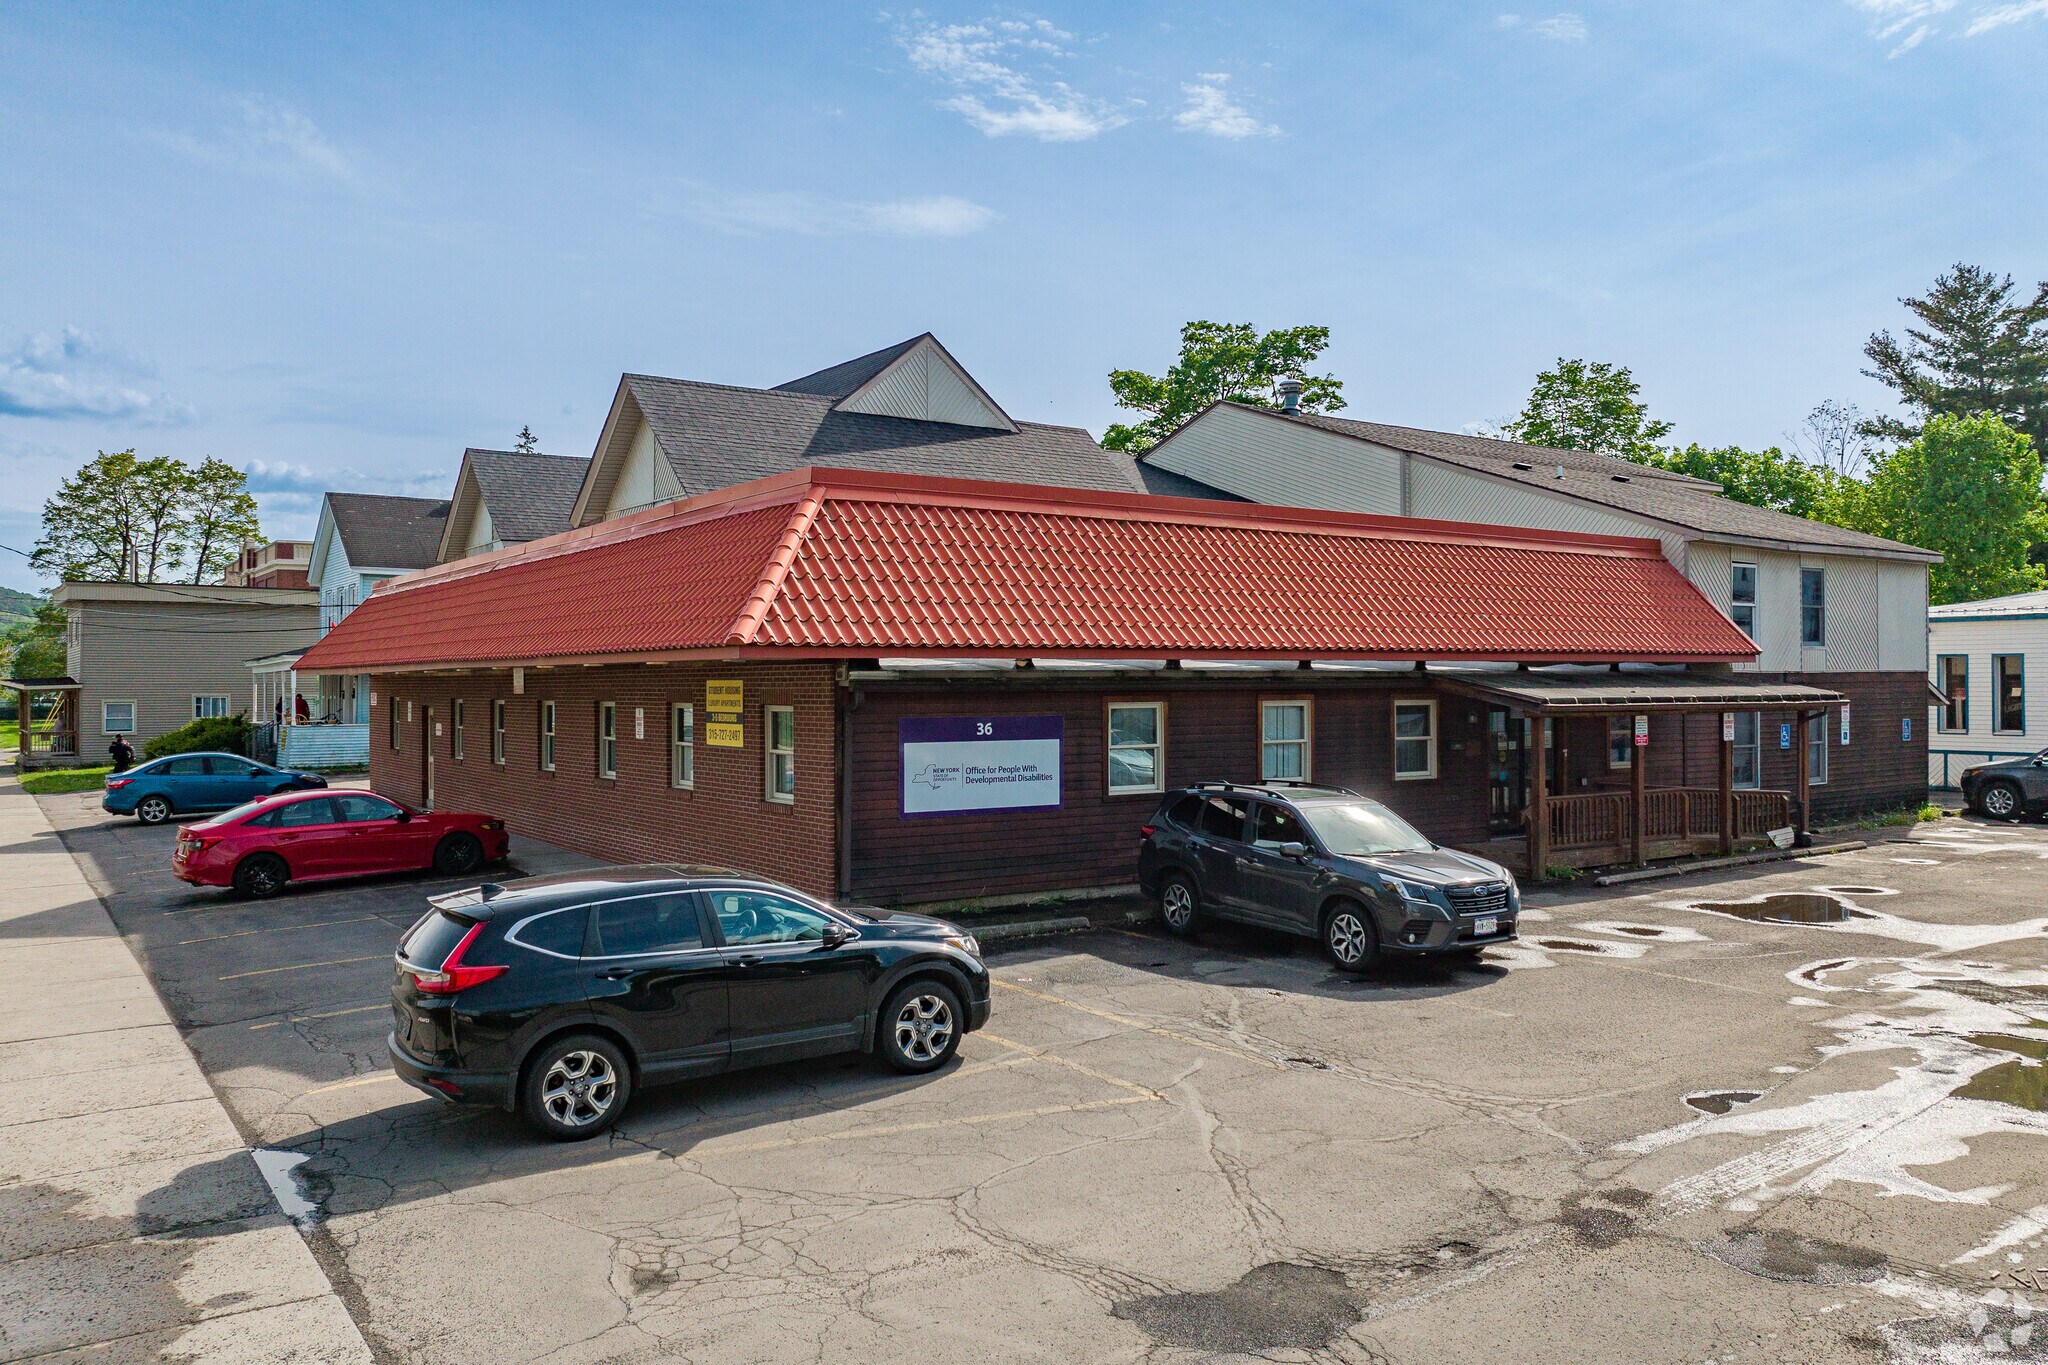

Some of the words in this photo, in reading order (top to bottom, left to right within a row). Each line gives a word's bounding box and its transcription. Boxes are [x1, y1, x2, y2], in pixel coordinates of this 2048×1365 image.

[976, 722, 993, 735] 36
[965, 766, 986, 775] Office
[987, 766, 997, 774] for
[998, 765, 1021, 775] People
[1021, 764, 1038, 773] With
[965, 775, 1017, 785] Developmental
[1017, 773, 1053, 782] Disabilities
